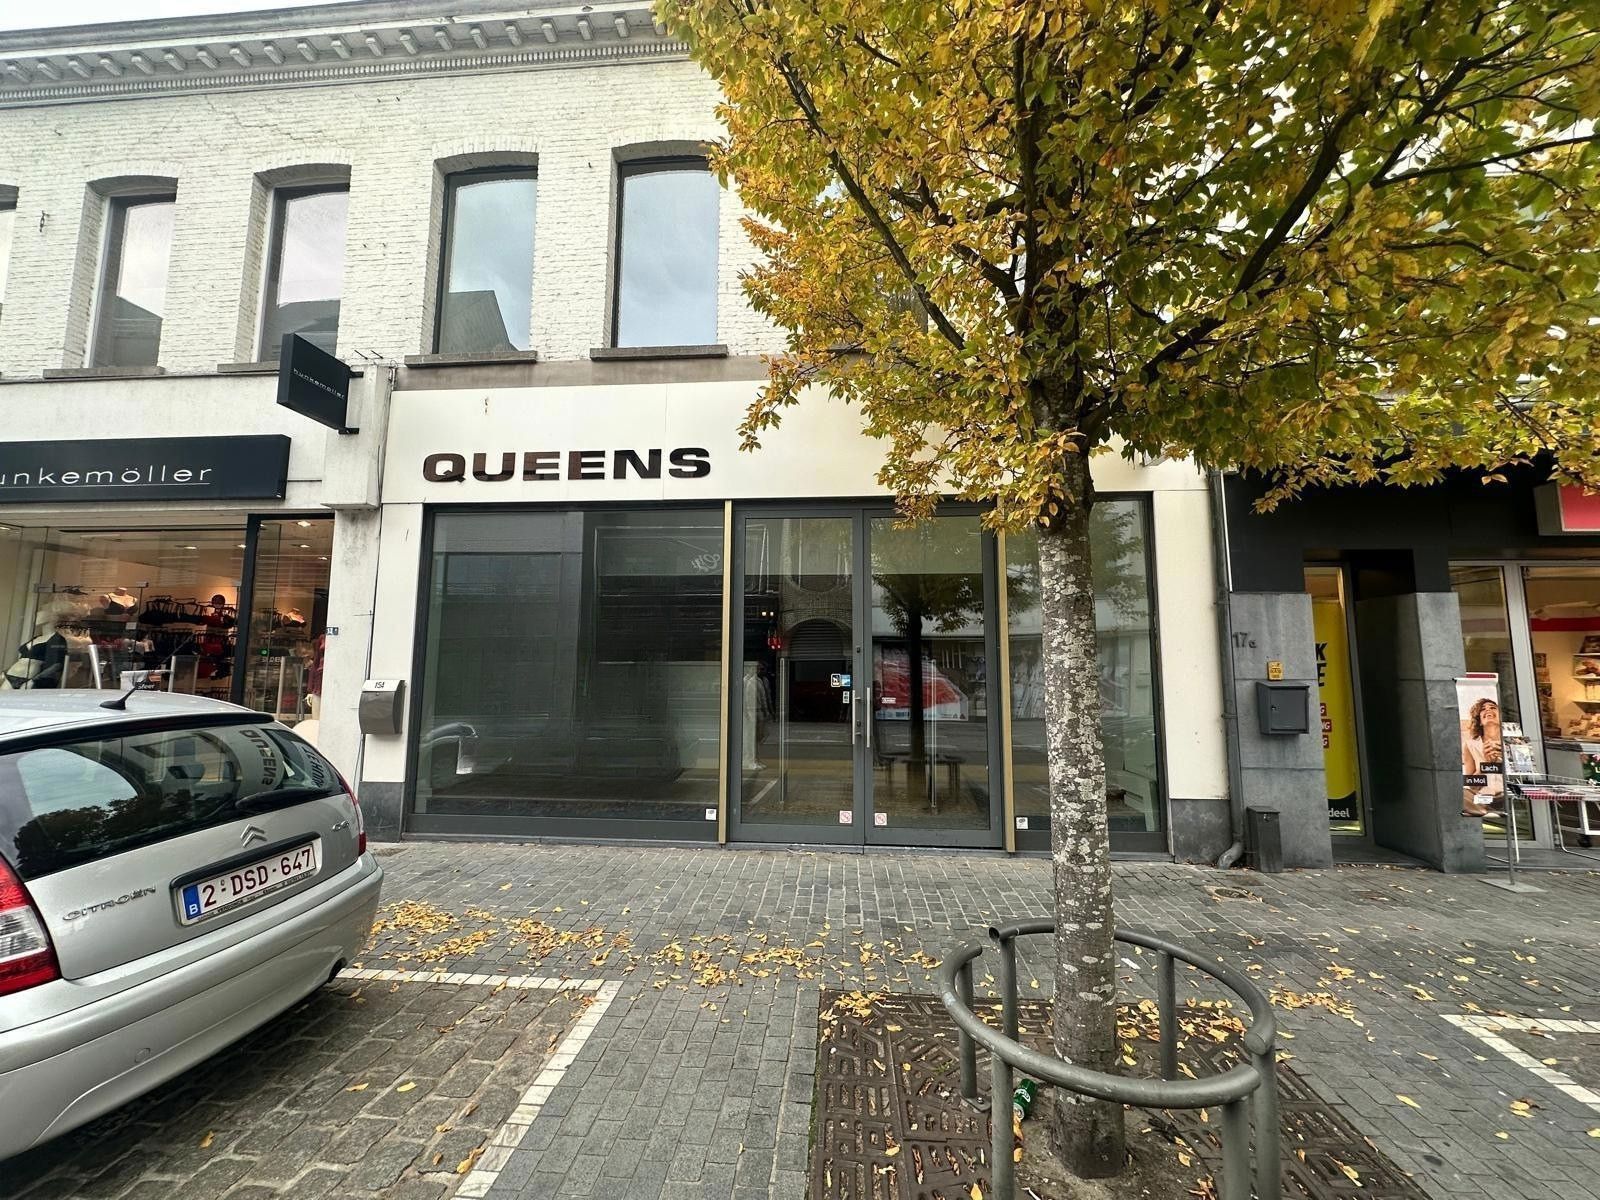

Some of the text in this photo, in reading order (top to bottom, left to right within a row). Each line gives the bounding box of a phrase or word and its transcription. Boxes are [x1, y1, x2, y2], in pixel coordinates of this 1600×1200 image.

[422, 447, 711, 483] QUEENS
[1480, 764, 1499, 772] Lach
[189, 903, 198, 915] B
